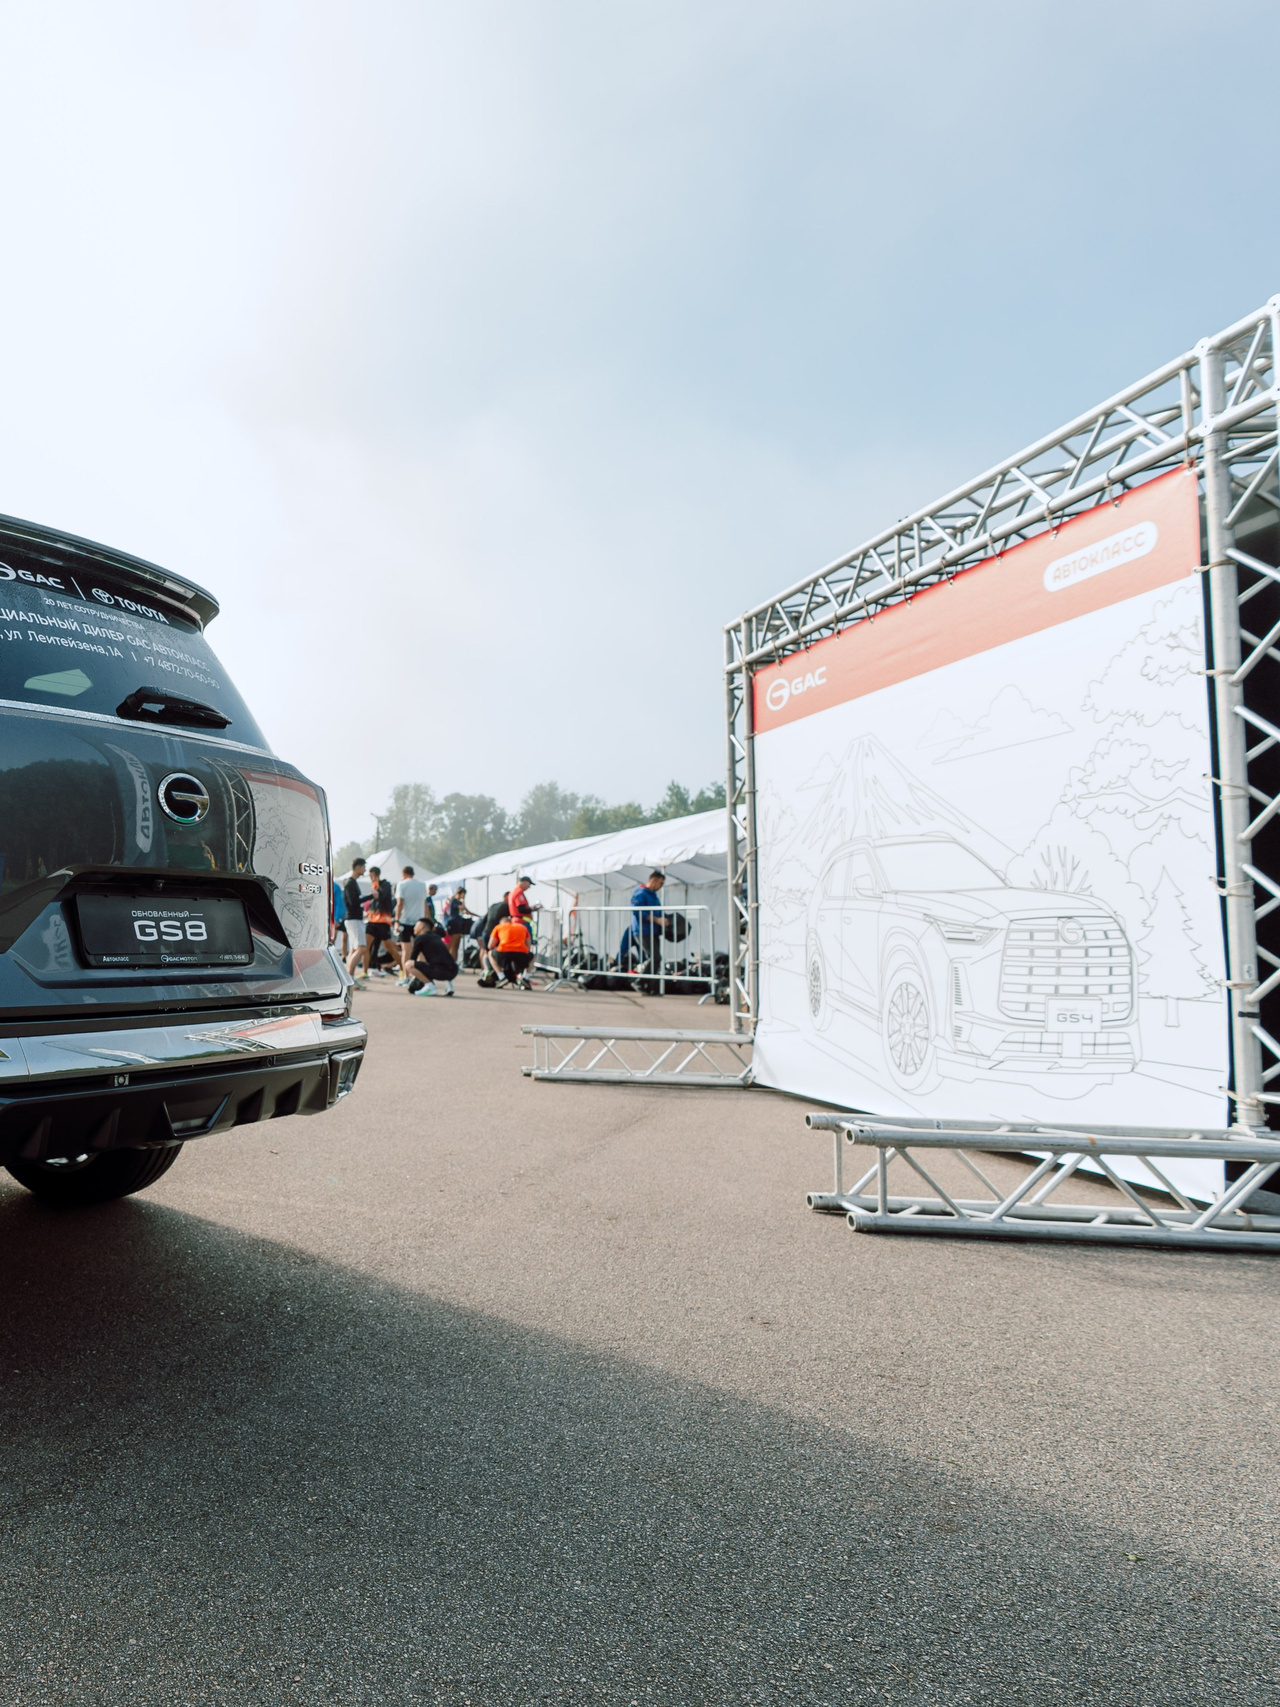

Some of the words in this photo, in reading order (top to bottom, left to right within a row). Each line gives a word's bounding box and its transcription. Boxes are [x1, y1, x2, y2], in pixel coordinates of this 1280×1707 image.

[1052, 531, 1146, 582] АВТОКЛАСС
[17, 569, 65, 589] GAC
[43, 597, 55, 606] 20
[56, 600, 72, 610] ЛЕТ
[115, 596, 170, 624] TOYOTA
[82, 623, 125, 642] ДИЛЕР
[126, 634, 152, 650] GAC
[152, 642, 211, 672] АВТОКЛАСС
[143, 656, 155, 666] +7
[791, 665, 827, 696] GAC
[299, 862, 324, 876] GS8
[132, 910, 190, 918] ОБНОВЛЕННЫЙ
[133, 920, 208, 941] GS8
[1057, 1013, 1094, 1024] GS4
